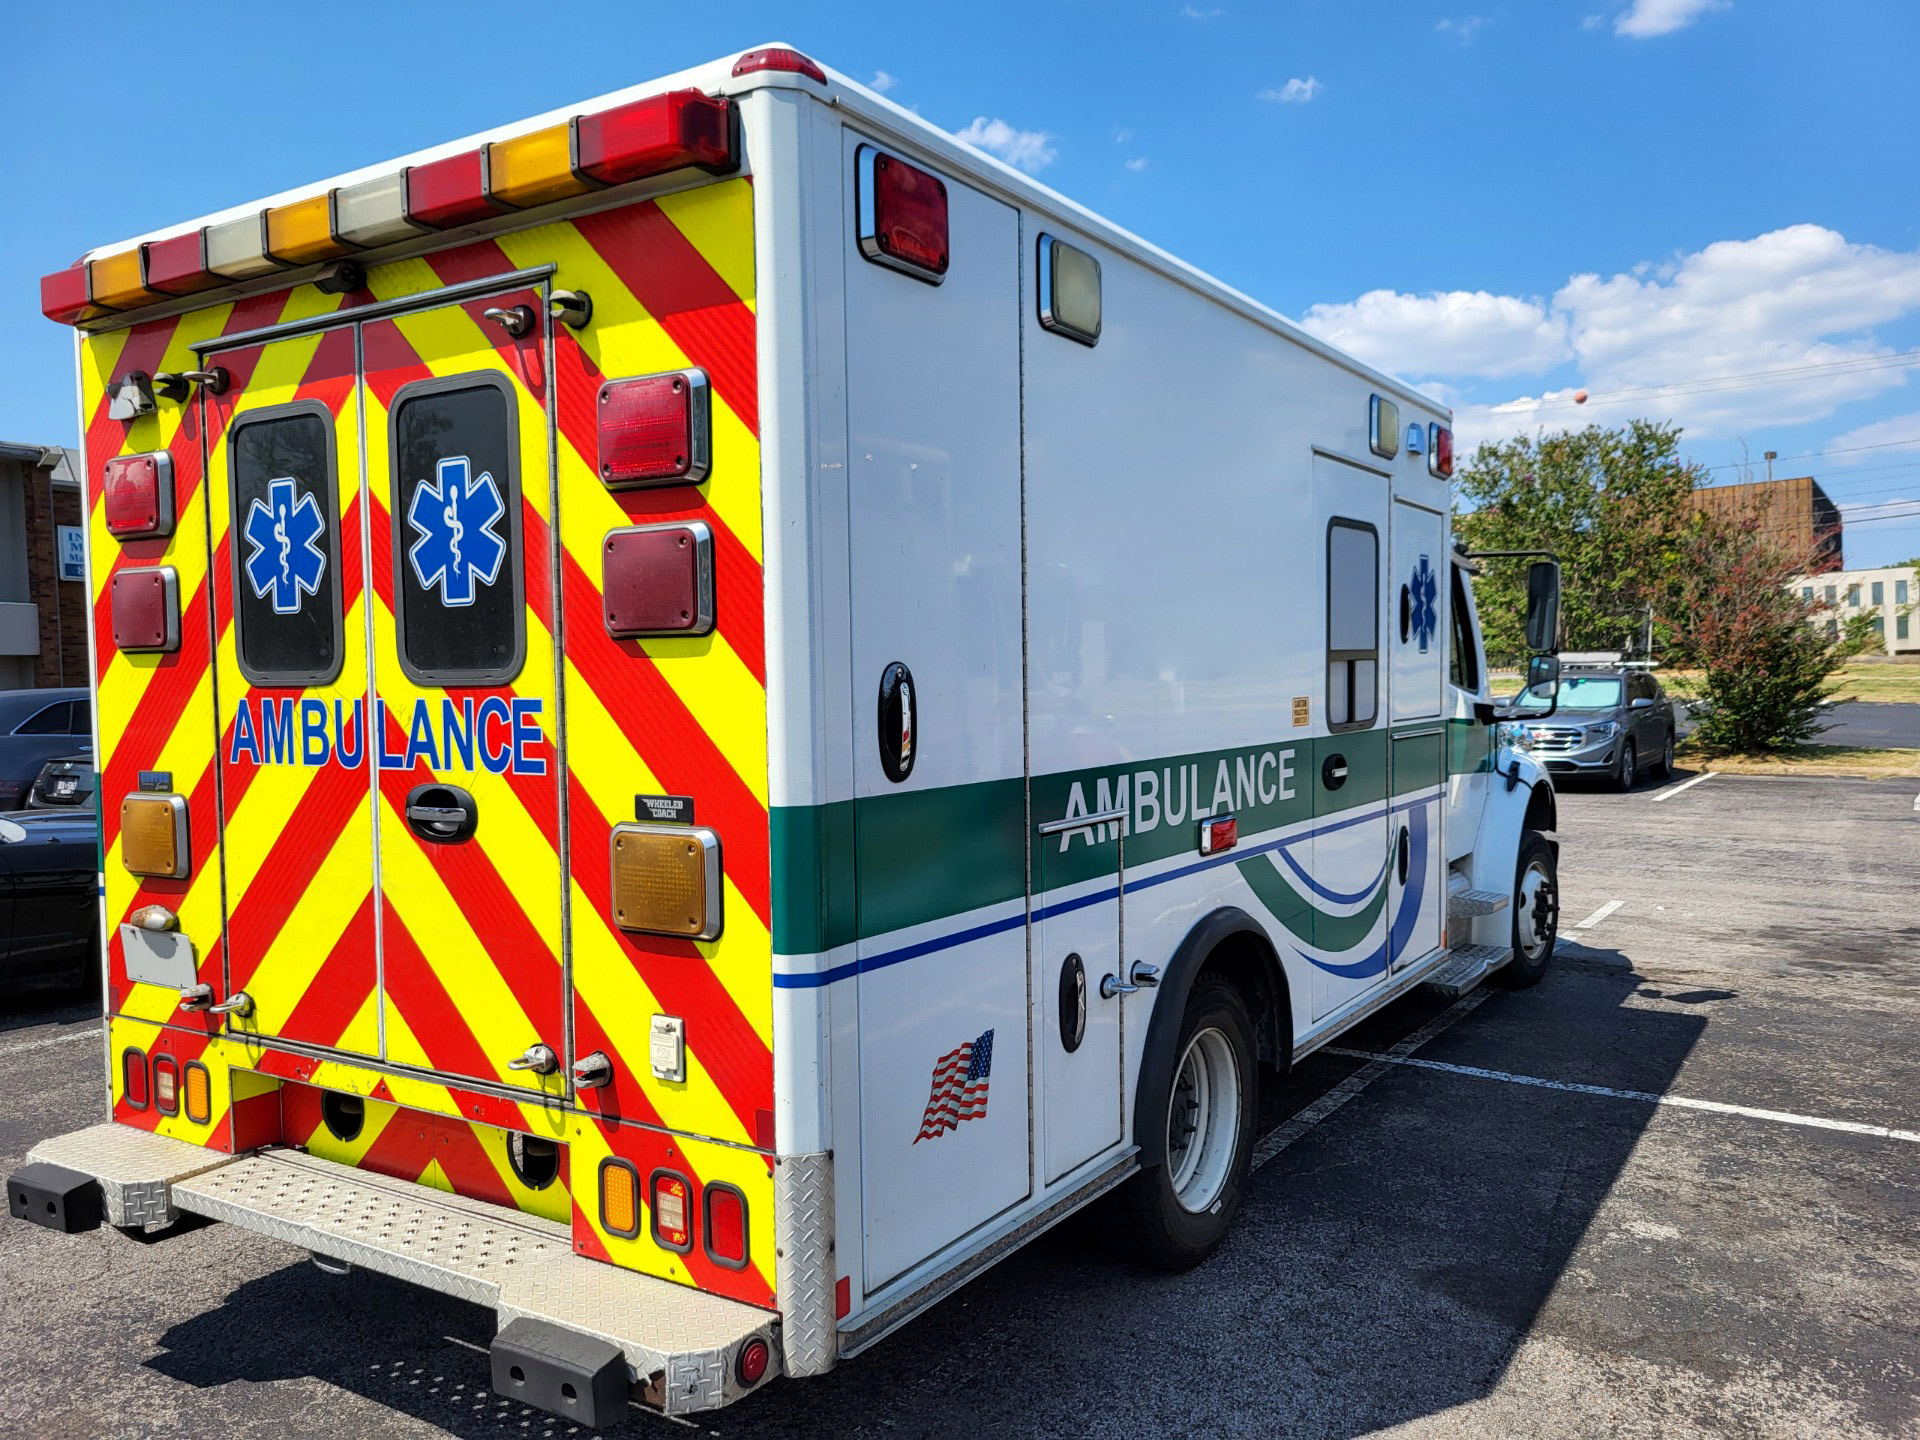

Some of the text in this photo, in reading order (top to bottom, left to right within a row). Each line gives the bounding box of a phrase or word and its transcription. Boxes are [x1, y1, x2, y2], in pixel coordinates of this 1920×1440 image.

[229, 696, 547, 775] AMBULANCE
[648, 807, 677, 819] COACH
[1059, 749, 1296, 853] AMBULANCE
